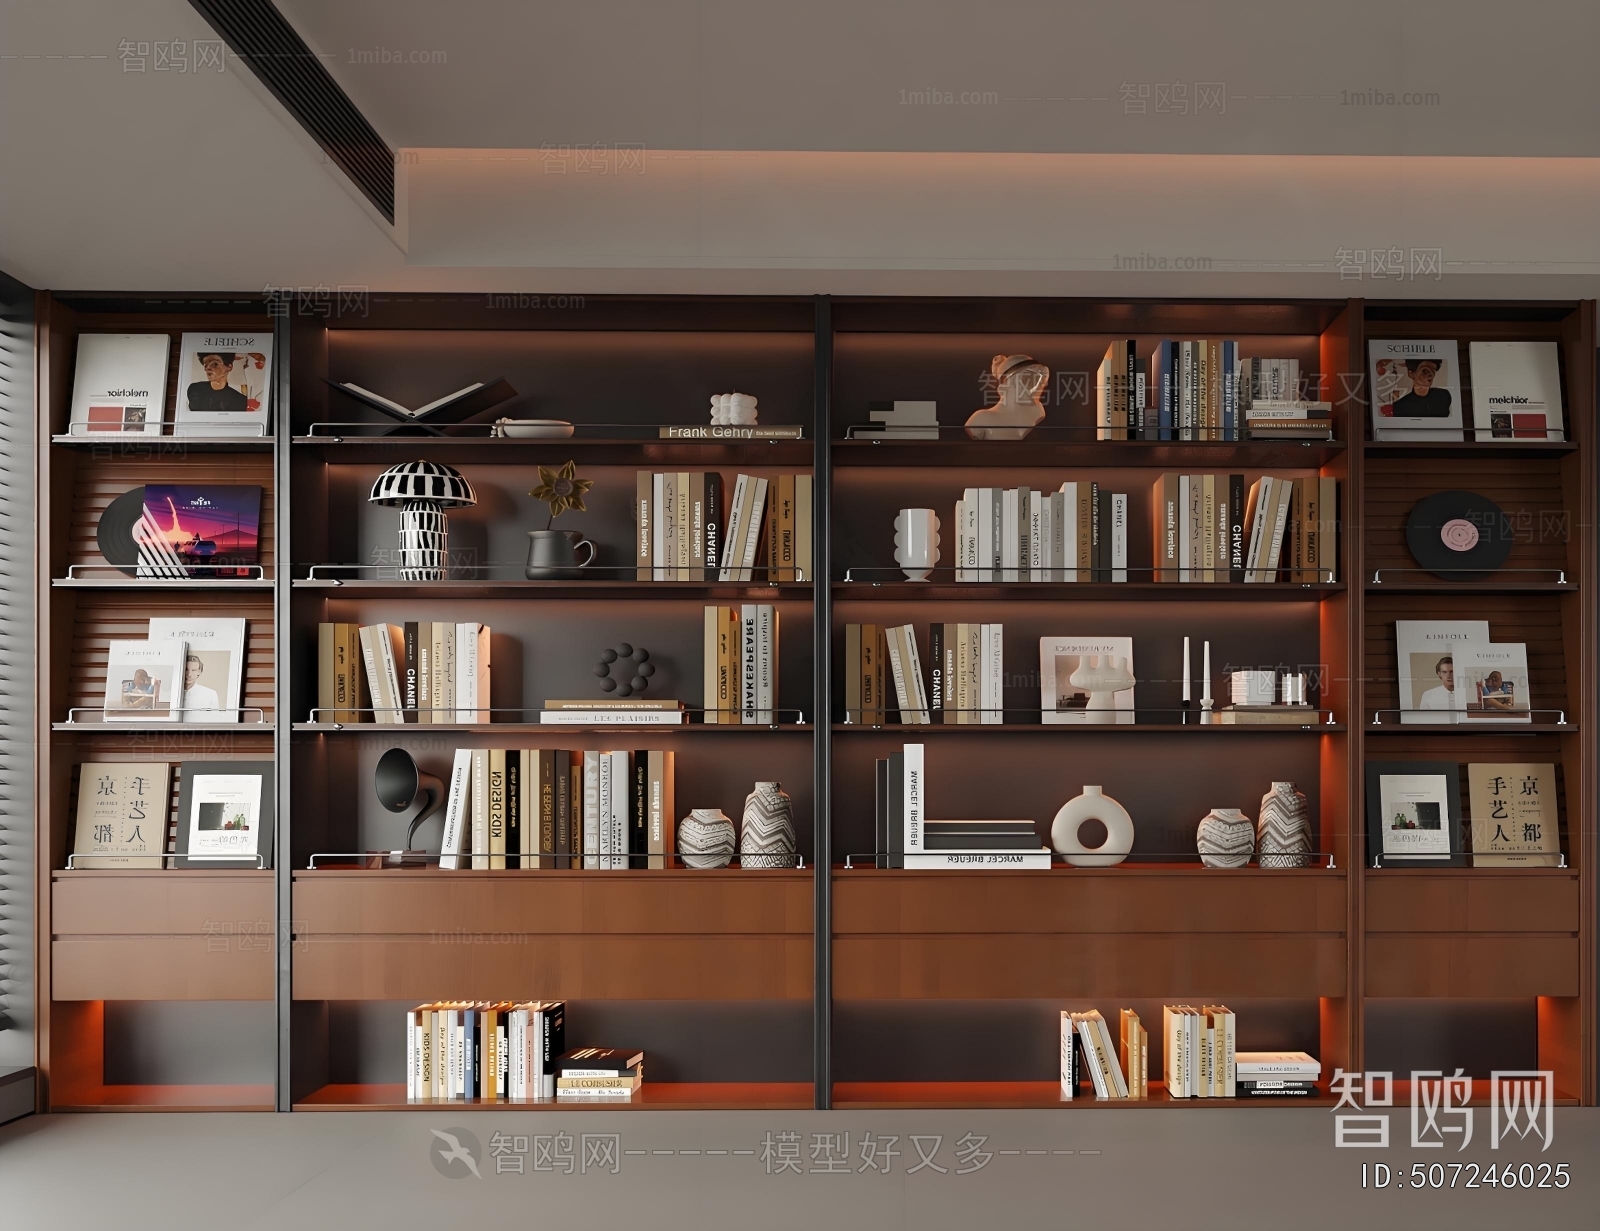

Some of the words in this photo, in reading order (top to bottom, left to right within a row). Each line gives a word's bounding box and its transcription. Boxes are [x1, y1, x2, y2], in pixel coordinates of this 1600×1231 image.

[1489, 395, 1529, 405] melchior
[669, 426, 707, 438] Frank
[712, 426, 753, 439] Gehry
[407, 668, 416, 709] CHANEL
[932, 669, 941, 710] CHANEL
[601, 758, 609, 807] MONROE
[585, 756, 598, 865] CENTURY
[1487, 776, 1511, 843] 手艺人
[1518, 775, 1542, 843] 京都
[601, 810, 609, 863] MARILYN
[422, 1032, 431, 1051] KIDS
[422, 1052, 431, 1082] DESIGN
